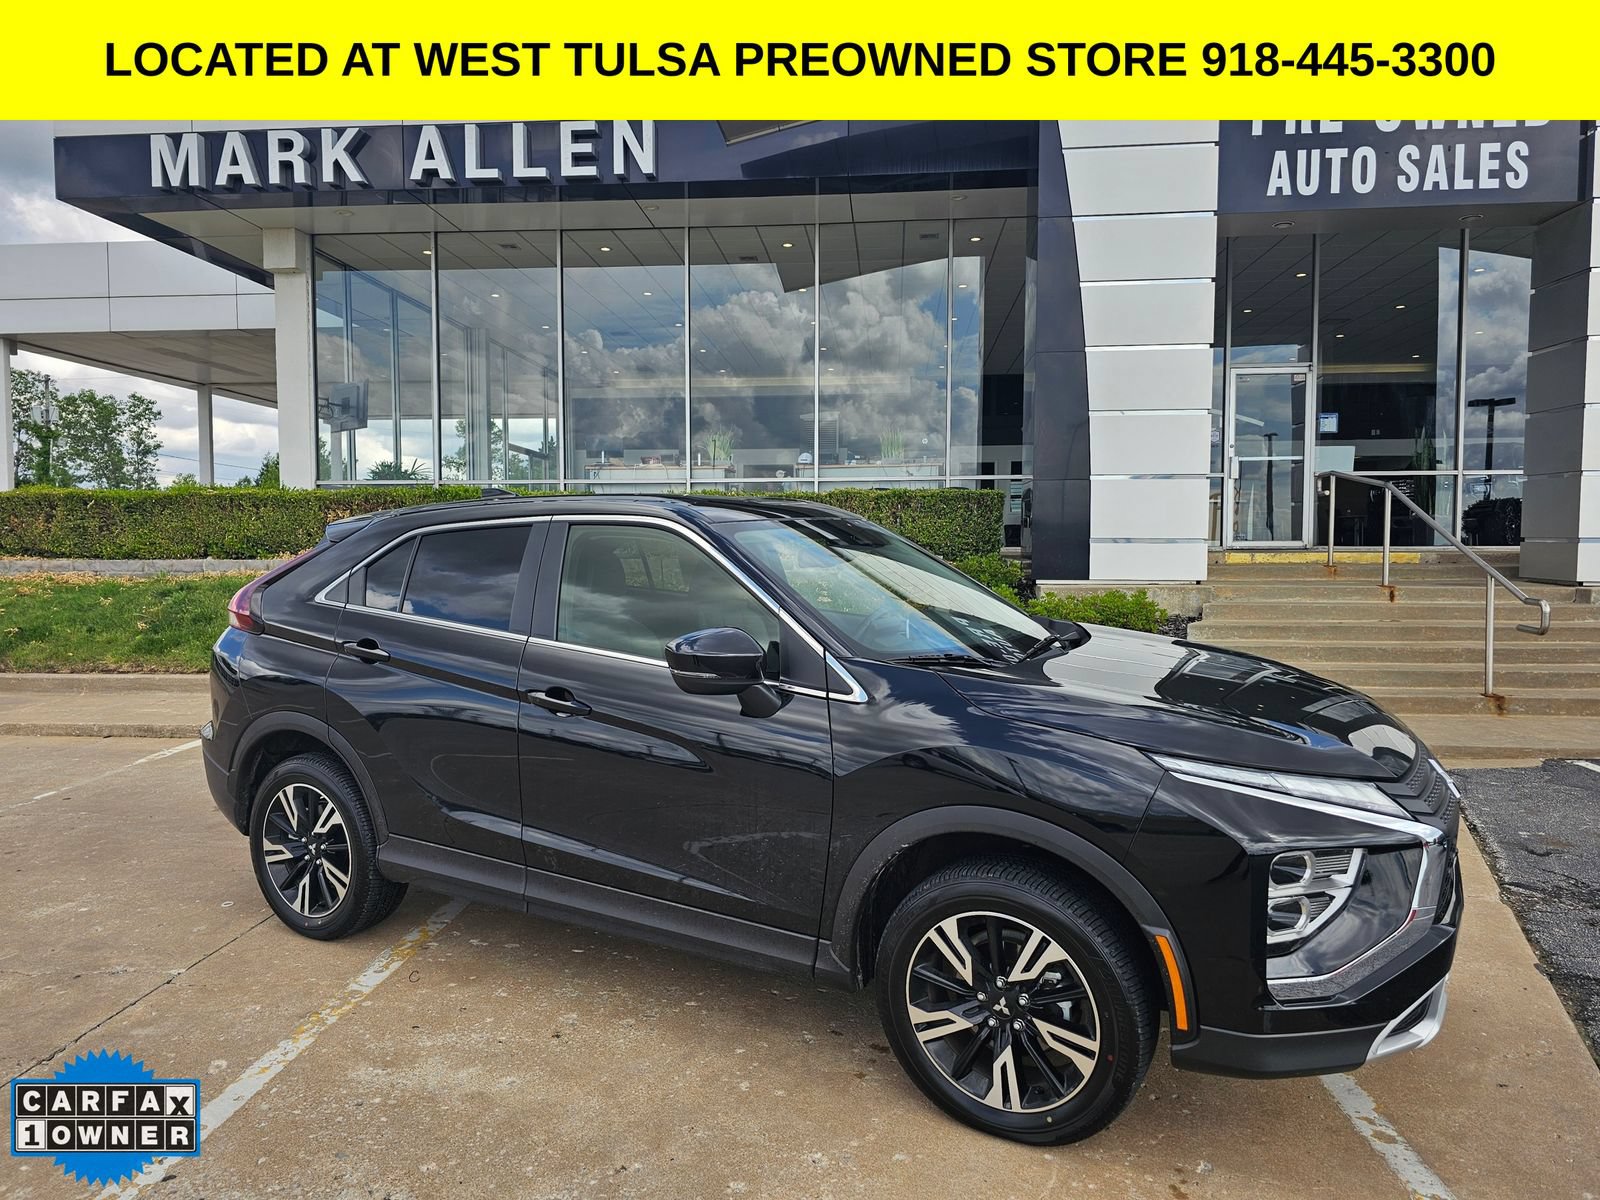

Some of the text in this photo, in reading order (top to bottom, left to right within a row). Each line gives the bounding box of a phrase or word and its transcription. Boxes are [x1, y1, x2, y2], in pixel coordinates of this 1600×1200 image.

[150, 119, 656, 189] MARK ALLEN
[1266, 140, 1529, 196] AUTO SALES
